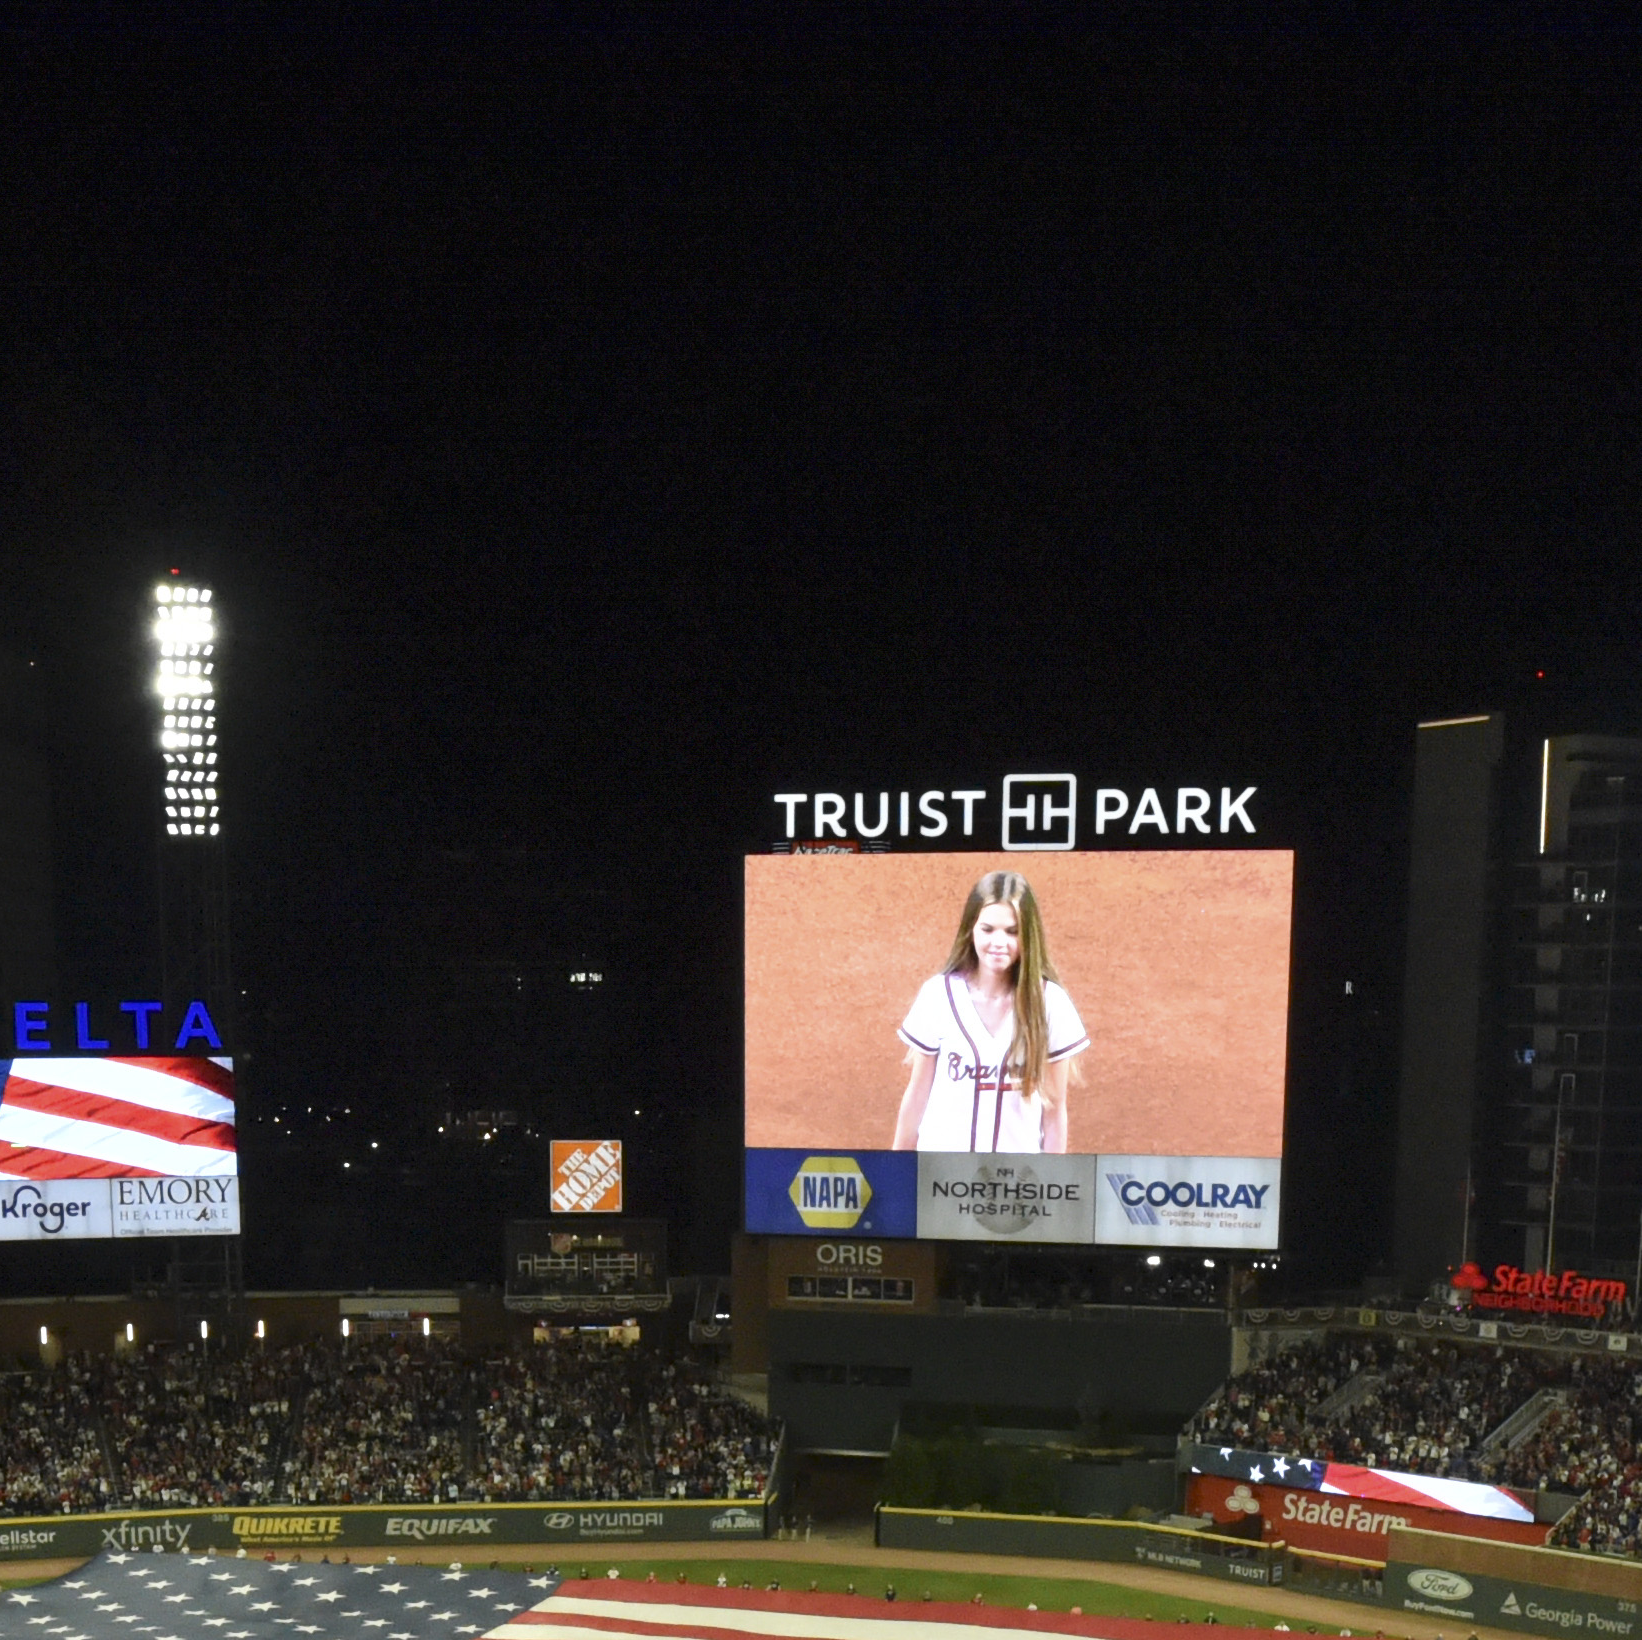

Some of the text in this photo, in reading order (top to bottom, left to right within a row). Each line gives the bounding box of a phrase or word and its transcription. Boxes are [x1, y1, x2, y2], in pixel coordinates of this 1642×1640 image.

[774, 787, 1257, 838] TRUIST PARK
[552, 1140, 621, 1211] HOME
[119, 1178, 232, 1206] EMORY
[579, 1167, 621, 1212] DEPOT
[803, 1176, 859, 1209] NAPA
[932, 1181, 1080, 1200] NORTHSIDE
[1121, 1181, 1271, 1210] COOLRAY
[1, 1185, 91, 1234] Kroger
[120, 1206, 229, 1222] HEALTHCARE
[958, 1203, 1052, 1217] HOSPITAL
[1203, 1211, 1238, 1220] Heating
[1219, 1220, 1261, 1229] Electrical
[816, 1244, 883, 1265] ORIS
[232, 1516, 342, 1536] QUIKRETE
[385, 1517, 493, 1540] EQUIFAX
[580, 1512, 663, 1528] HYUNDAI
[101, 1519, 192, 1550] xfinity
[1228, 1563, 1265, 1580] TRUIST
[1421, 1573, 1459, 1596] Ford
[1525, 1601, 1633, 1635] Georgia Power
